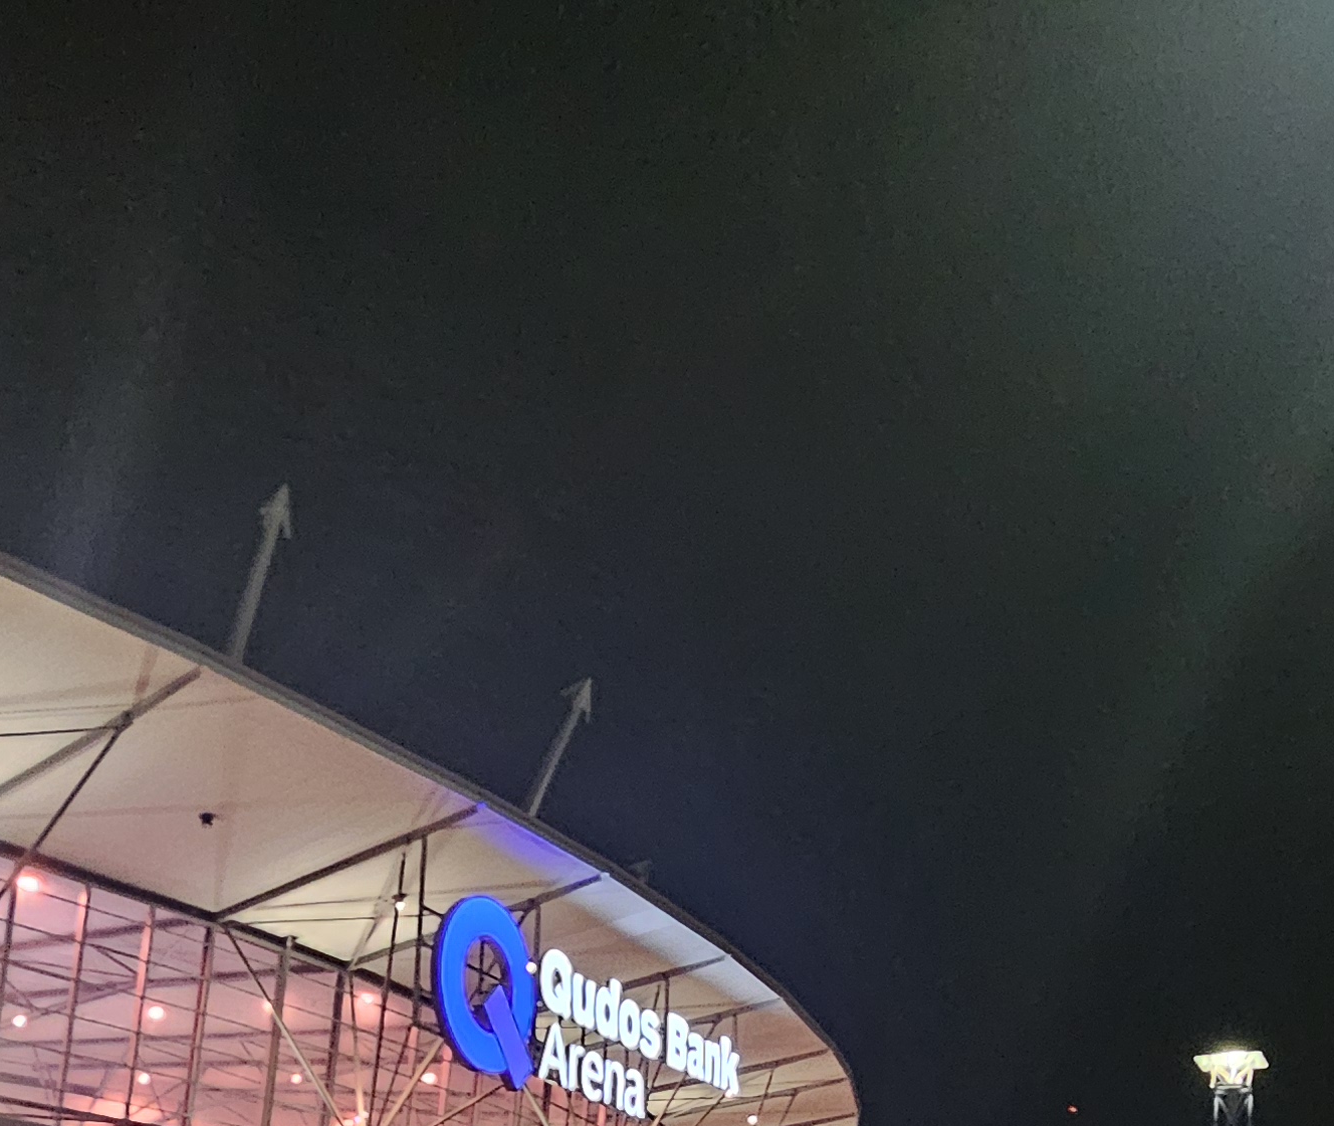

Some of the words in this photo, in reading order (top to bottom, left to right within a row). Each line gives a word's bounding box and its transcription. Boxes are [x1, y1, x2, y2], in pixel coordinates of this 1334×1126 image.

[433, 895, 536, 1090] Q
[540, 948, 662, 1060] Qudos
[666, 1012, 740, 1098] Bank
[538, 1022, 646, 1119] Arena
